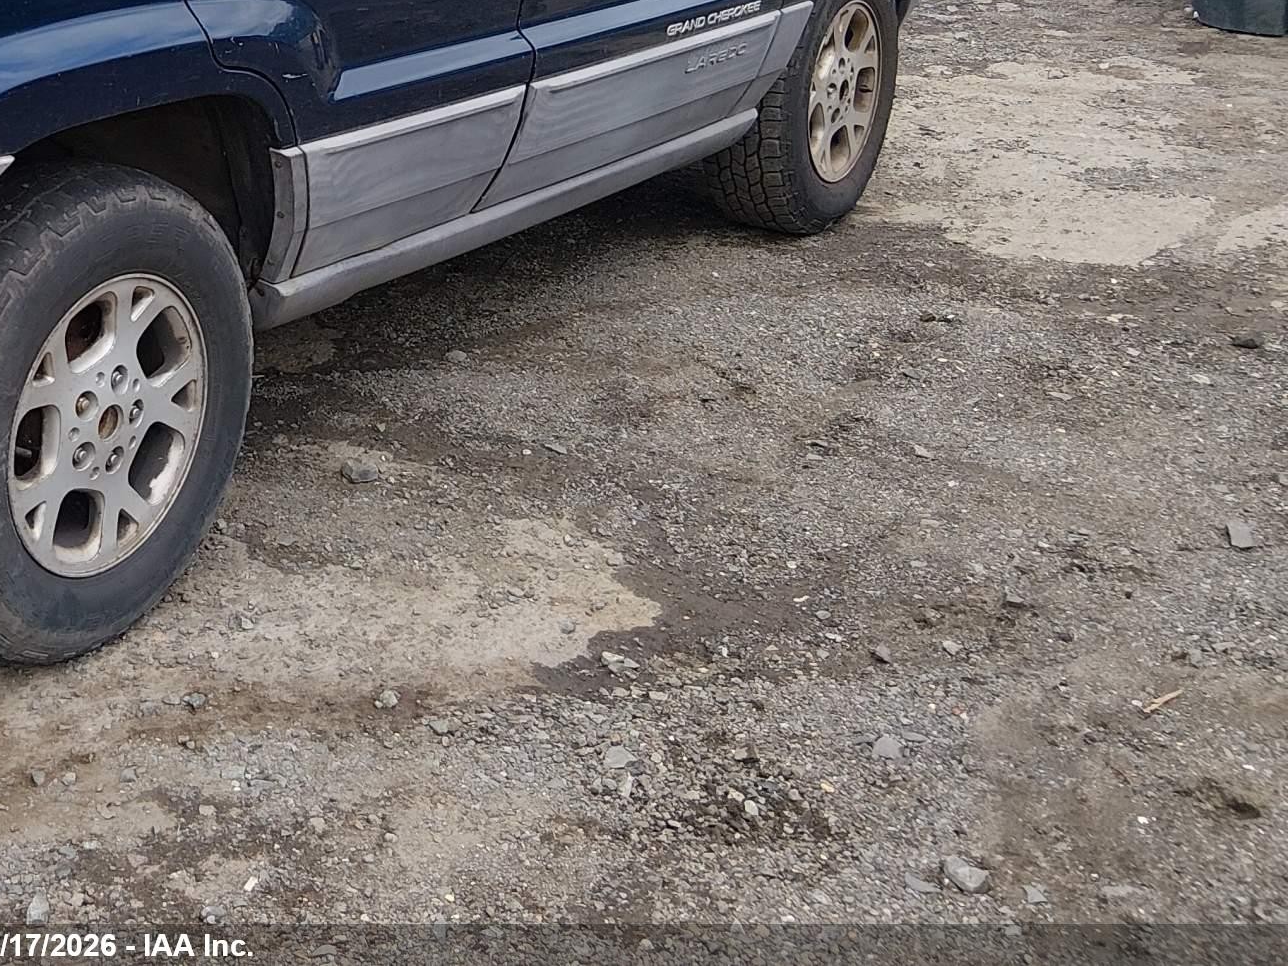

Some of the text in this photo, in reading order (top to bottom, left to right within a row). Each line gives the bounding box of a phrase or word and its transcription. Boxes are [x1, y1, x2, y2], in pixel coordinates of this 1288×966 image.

[666, 0, 762, 36] GRAND CHEROKEE
[684, 42, 748, 74] LAREDO
